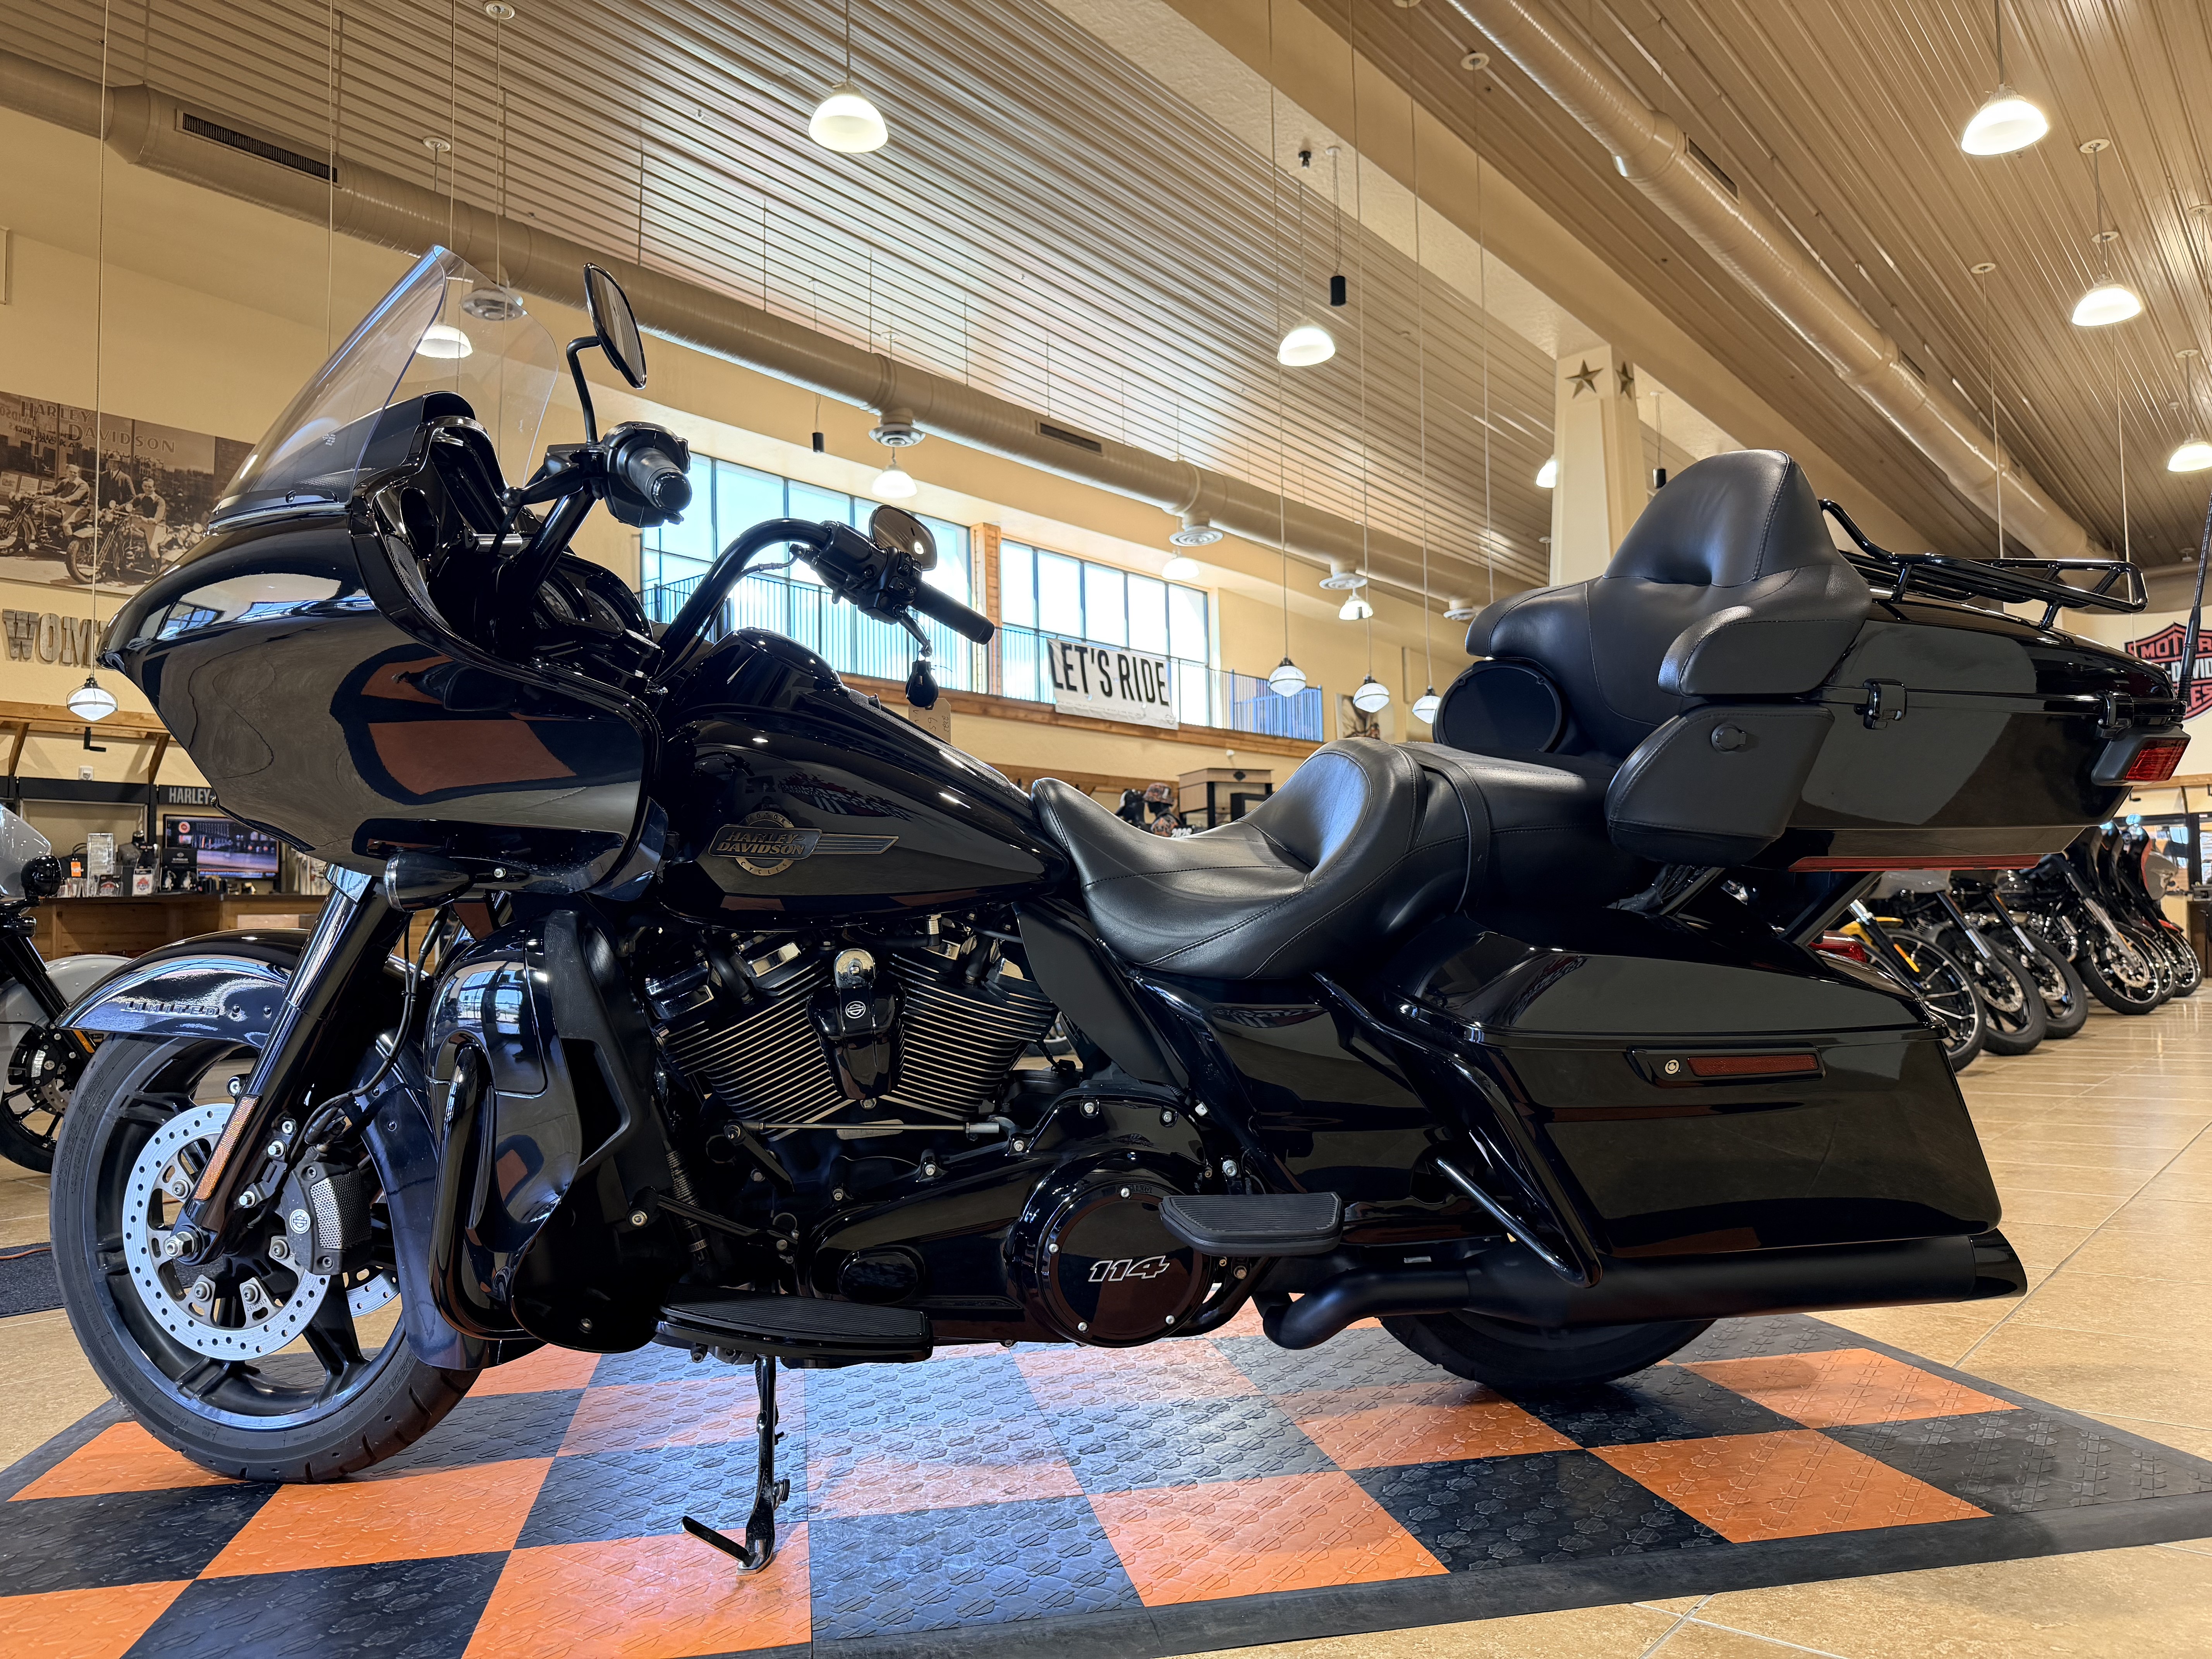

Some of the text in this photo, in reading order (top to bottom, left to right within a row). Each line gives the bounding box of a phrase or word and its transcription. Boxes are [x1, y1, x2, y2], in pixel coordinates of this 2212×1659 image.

[21, 401, 101, 423] HARLEY-
[68, 422, 175, 453] DAVIDSON
[2, 608, 109, 666] WOM
[2141, 633, 2212, 658] MOTR
[1047, 642, 1170, 706] LET'S RIDE
[169, 787, 215, 805] HARLEY-
[716, 842, 806, 855] DAVIDSON
[725, 832, 805, 844] HARLEY-
[740, 861, 788, 875] CYCLES
[123, 1001, 220, 1017] LIMITED
[1087, 1255, 1170, 1282] 114
